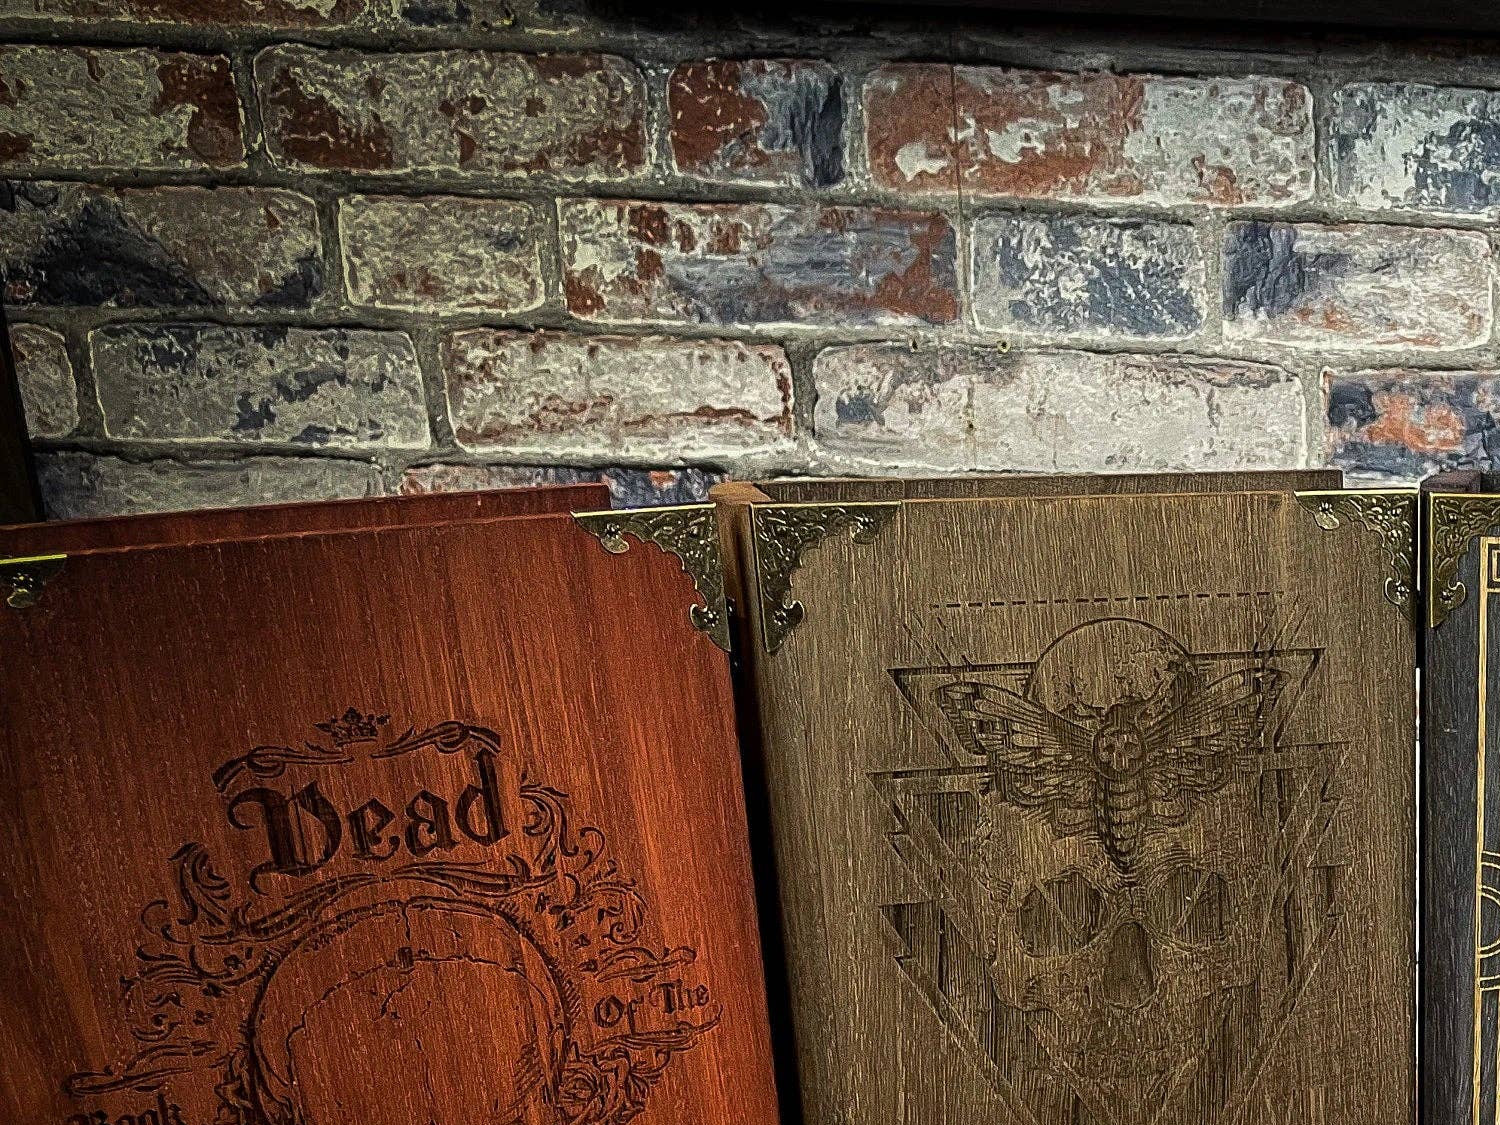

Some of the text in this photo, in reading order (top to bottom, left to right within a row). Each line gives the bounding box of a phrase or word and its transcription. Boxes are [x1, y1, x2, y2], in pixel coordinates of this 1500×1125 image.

[227, 749, 511, 895] Dead
[594, 979, 709, 1035] Of The
